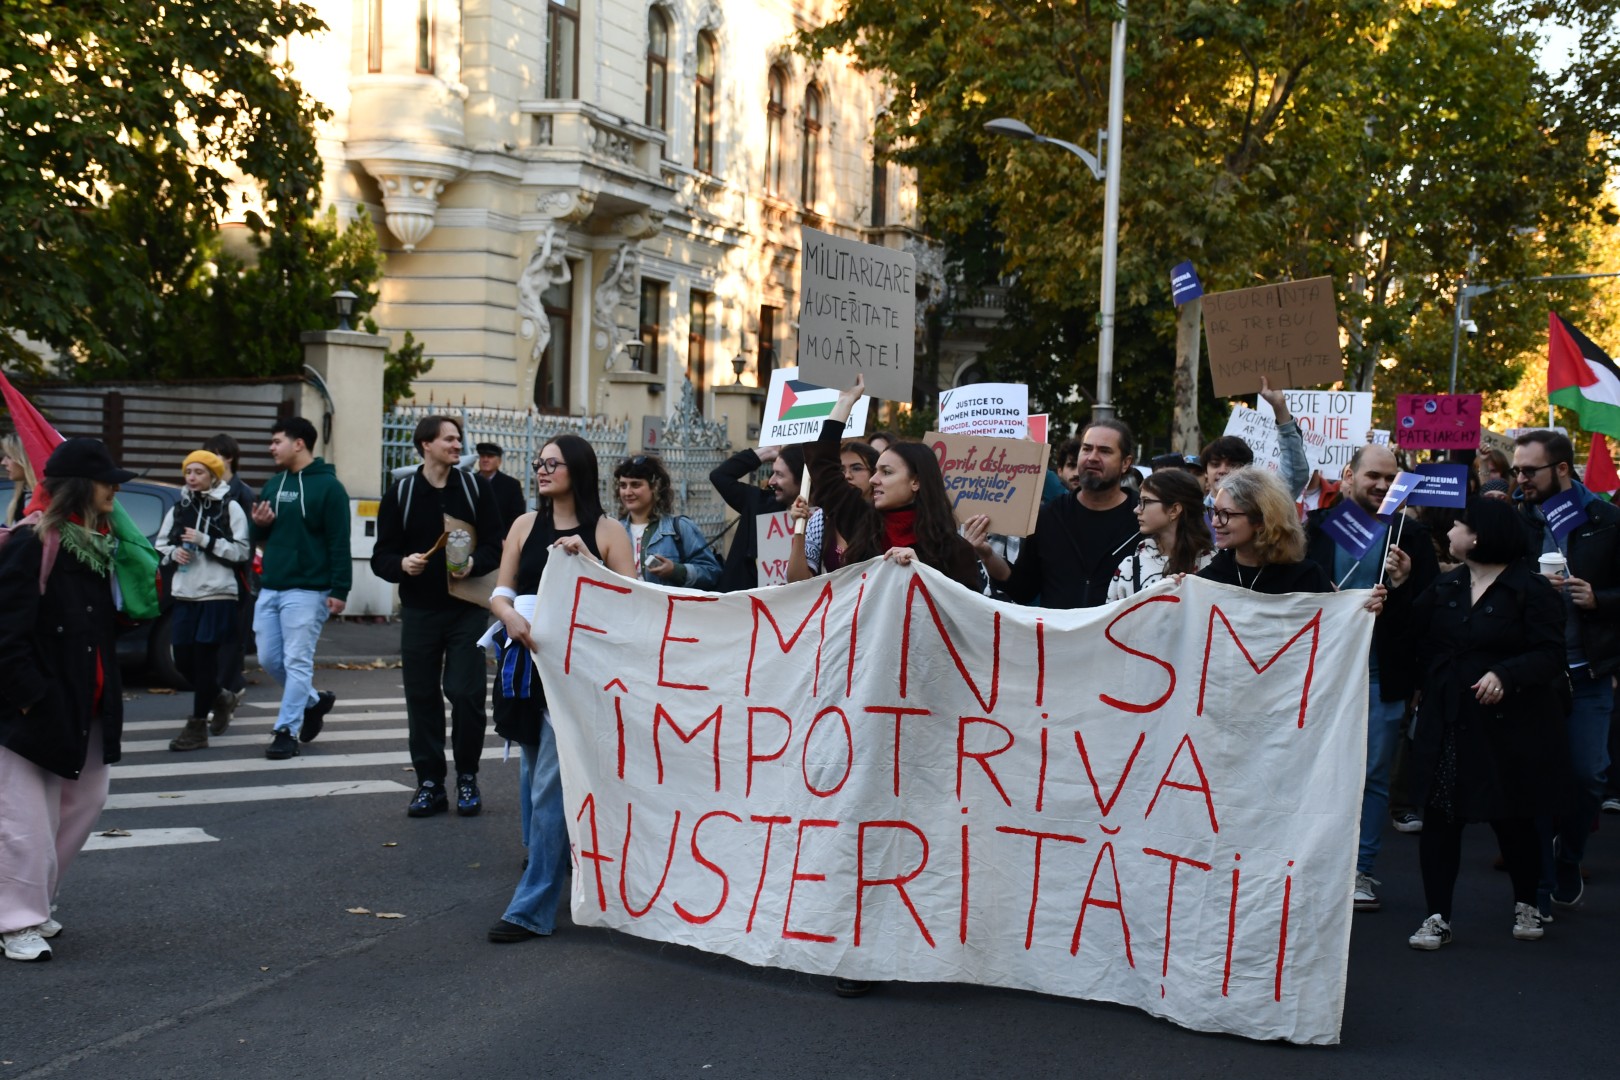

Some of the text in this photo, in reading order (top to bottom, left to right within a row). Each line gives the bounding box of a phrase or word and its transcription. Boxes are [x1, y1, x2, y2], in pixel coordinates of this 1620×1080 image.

[804, 287, 900, 329] AUSTERITATE
[806, 334, 899, 370] MOARTE!
[956, 398, 988, 409] JUSTICE
[1328, 394, 1356, 414] TOT
[1410, 398, 1469, 415] FCK
[944, 408, 1020, 422] WOMEN ENDURING
[771, 421, 819, 438] PALESTINA
[979, 446, 1041, 481] distrugerea
[943, 473, 1011, 491] serviciilor
[953, 487, 1017, 509] publice!
